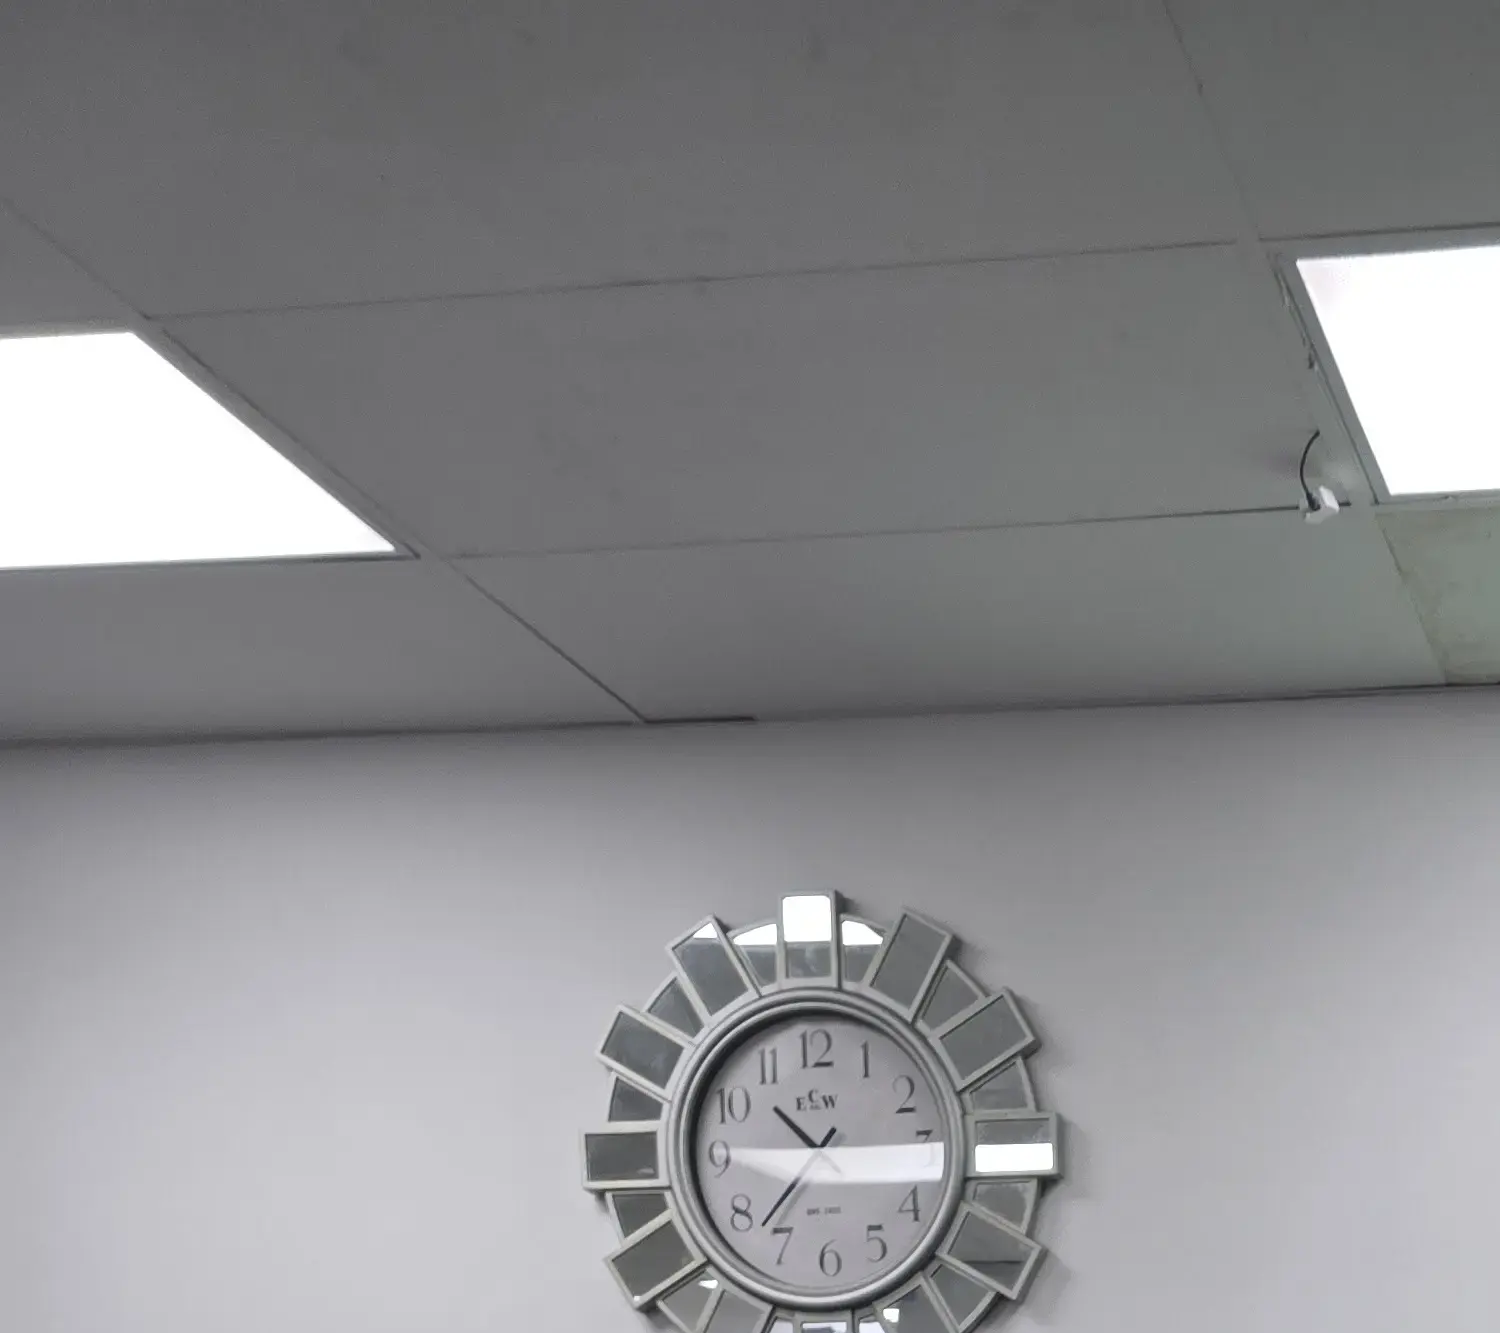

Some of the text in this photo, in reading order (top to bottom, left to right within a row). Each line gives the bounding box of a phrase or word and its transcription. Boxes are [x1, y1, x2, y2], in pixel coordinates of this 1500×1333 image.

[758, 1048, 779, 1085] 11
[799, 1028, 834, 1070] 12
[860, 1040, 870, 1078] 1
[716, 1086, 751, 1125] 10
[892, 1075, 917, 1113] 2
[708, 1140, 731, 1178] 9
[730, 1194, 753, 1233] 8
[897, 1184, 921, 1223] 4
[771, 1226, 794, 1266] 7
[818, 1239, 842, 1278] 6
[866, 1223, 887, 1263] 5
